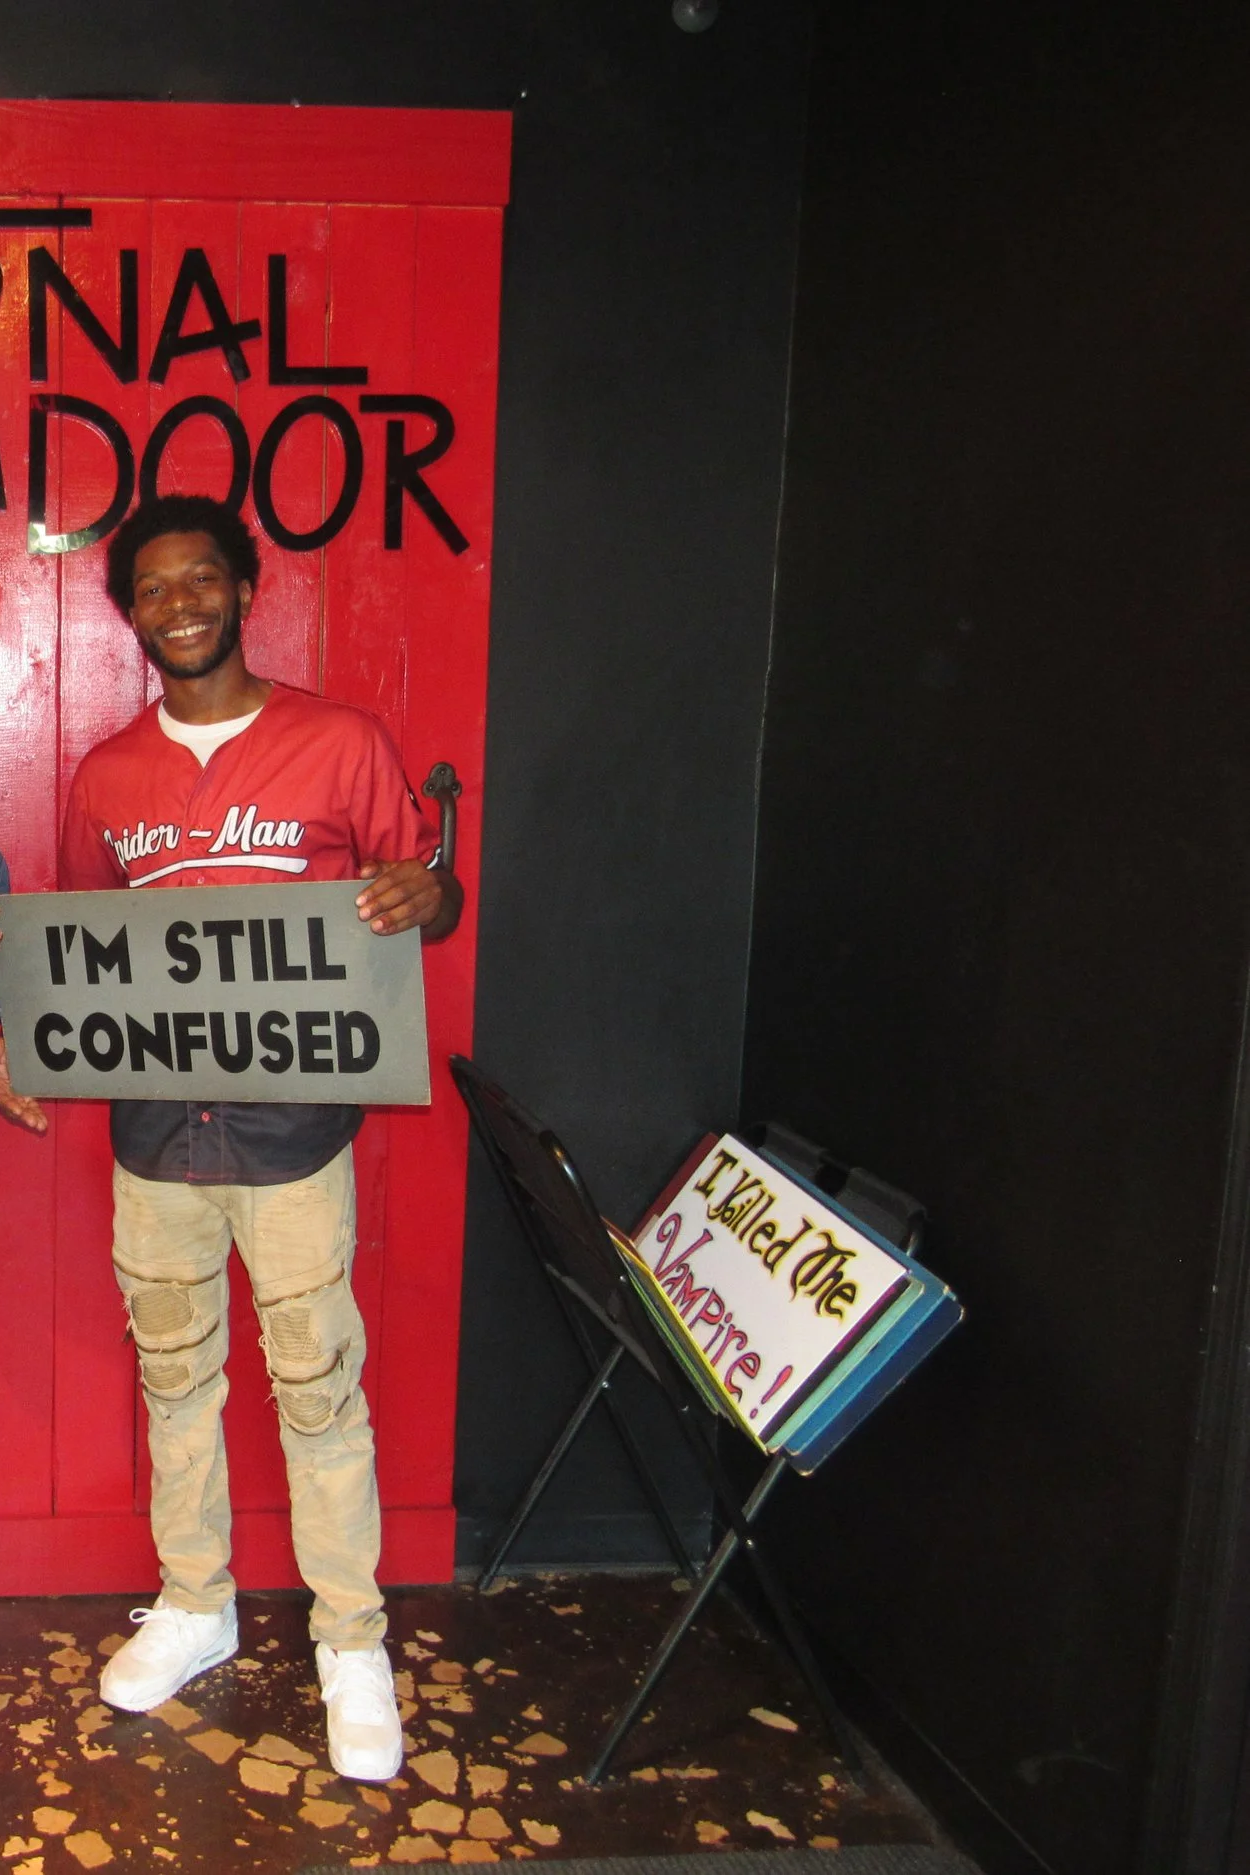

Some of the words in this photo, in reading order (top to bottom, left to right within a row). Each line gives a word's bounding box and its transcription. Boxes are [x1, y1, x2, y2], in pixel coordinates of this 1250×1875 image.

[27, 393, 471, 556] DOOR
[44, 923, 134, 986] I'M
[164, 916, 347, 984] STILL
[33, 1010, 381, 1074] CONFUSED
[694, 1149, 738, 1198] I
[707, 1168, 815, 1277] Killed
[789, 1230, 860, 1322] The
